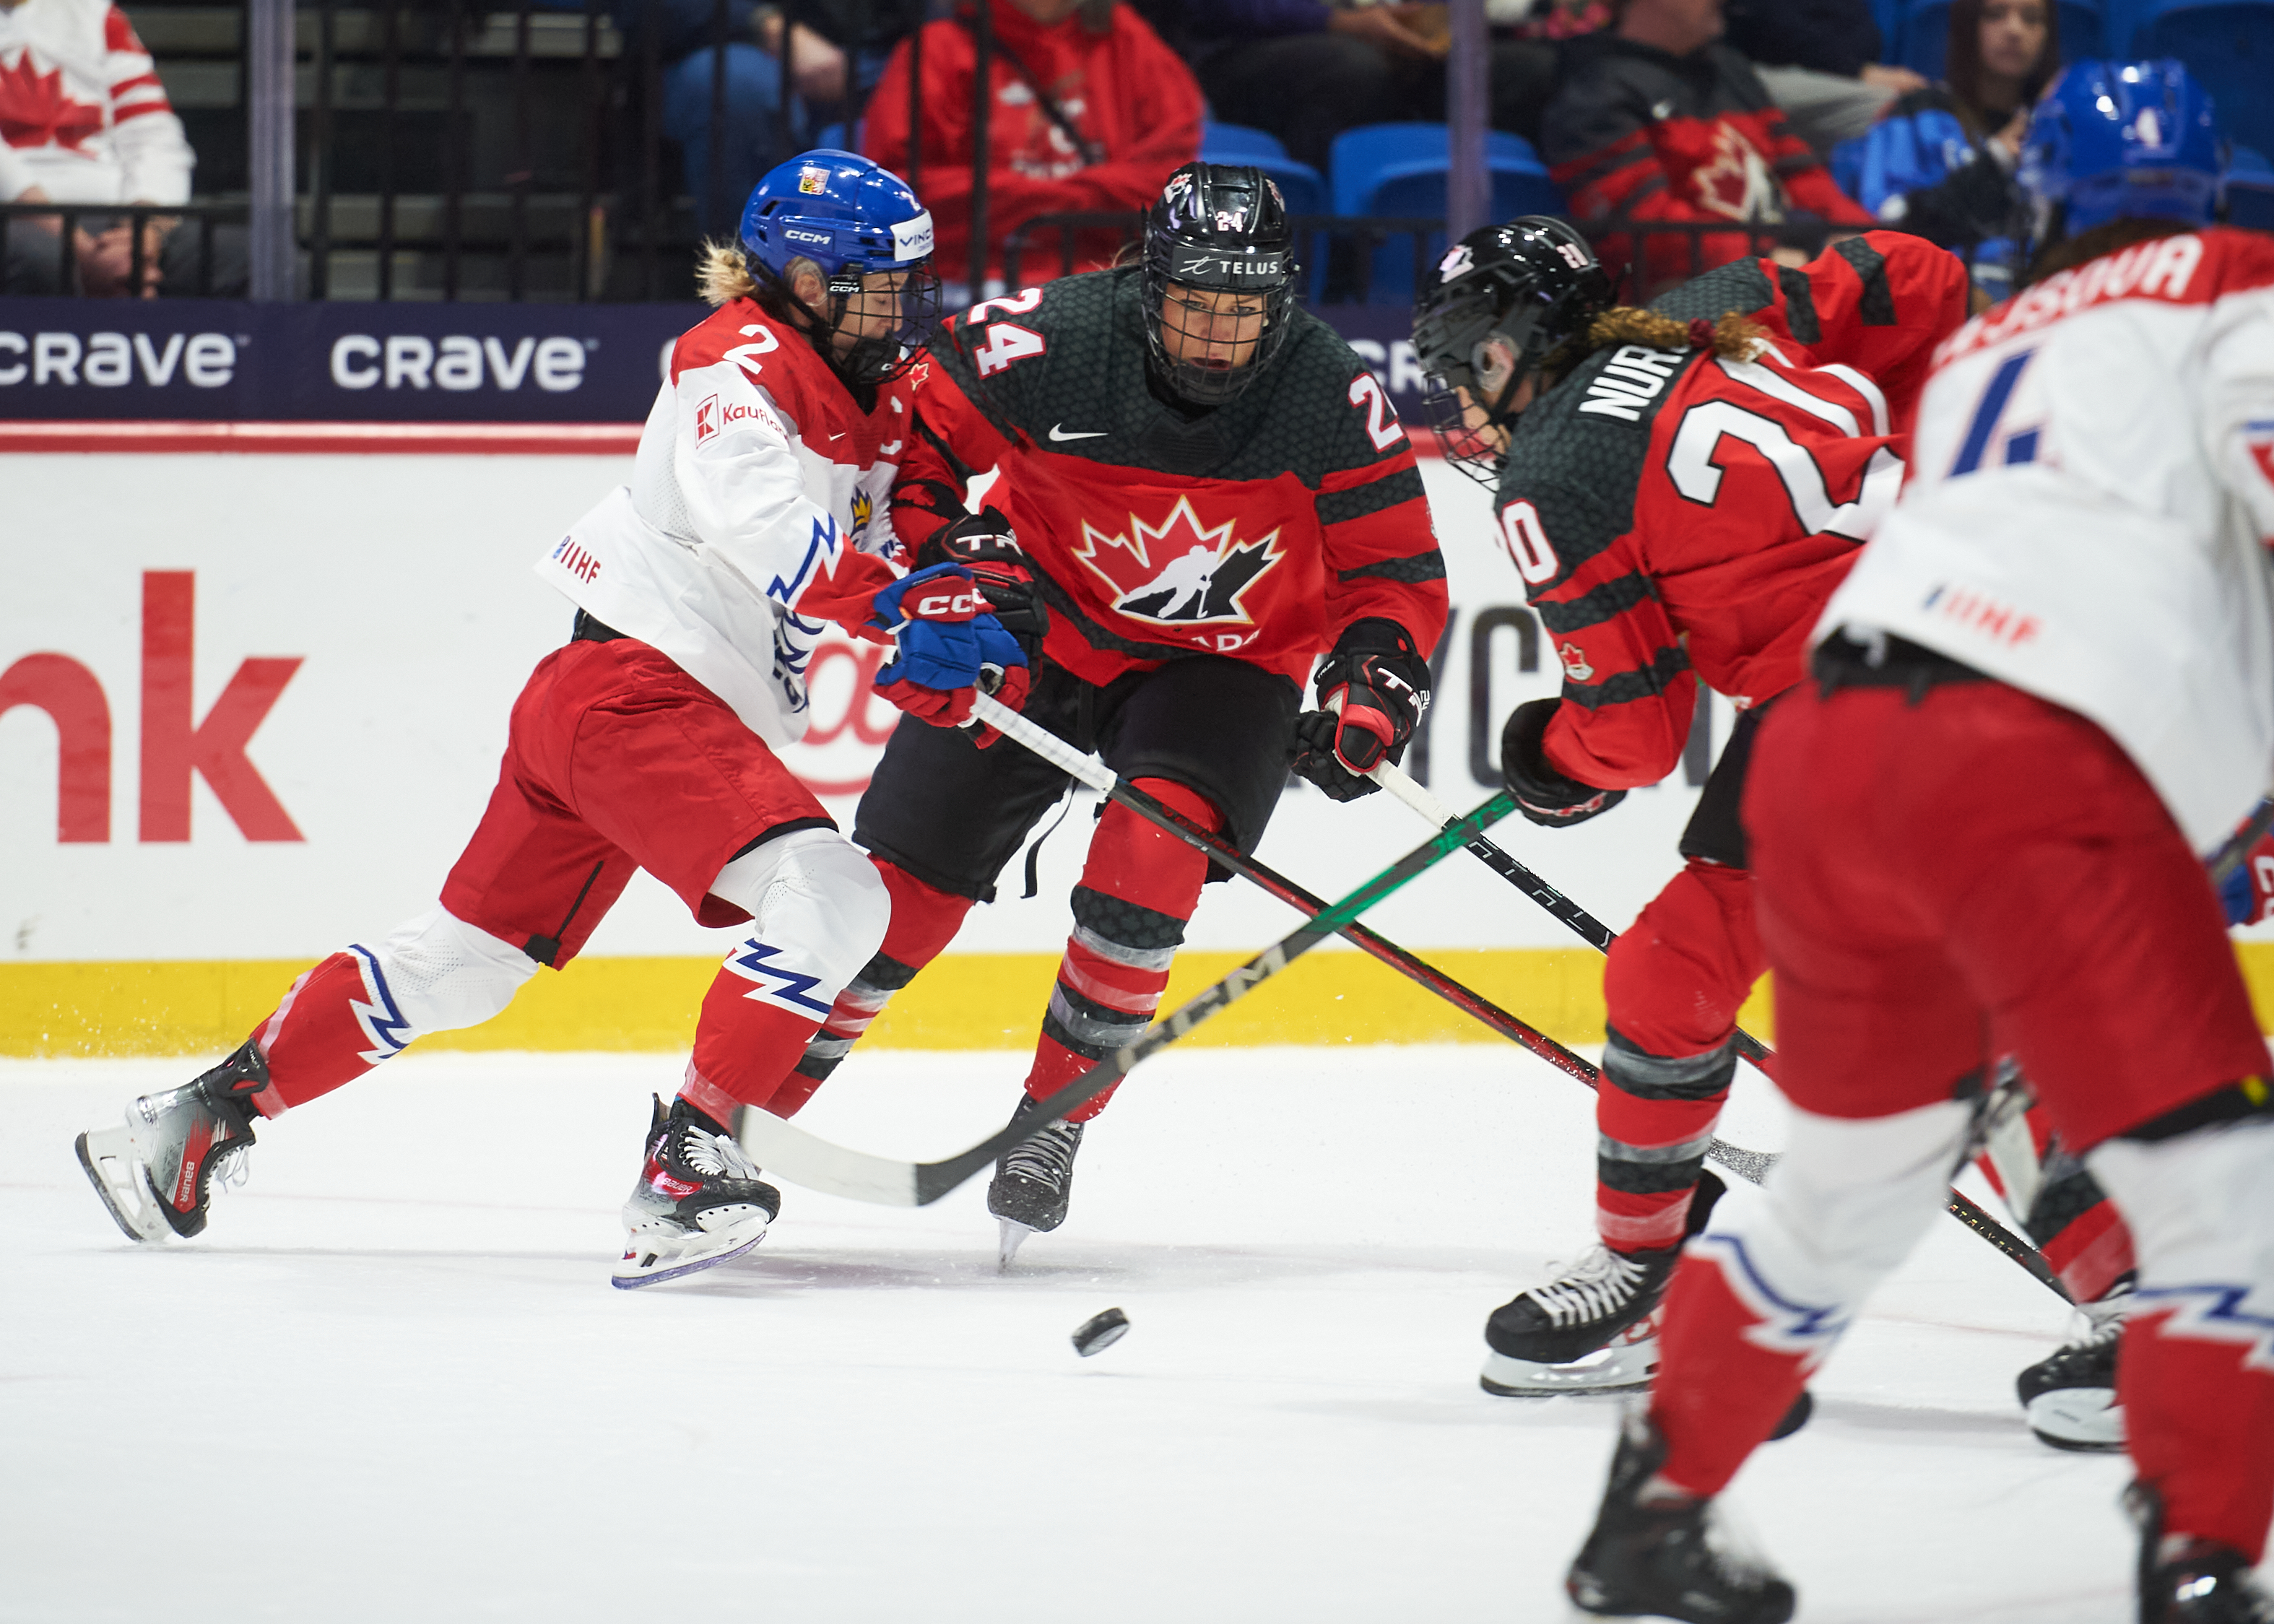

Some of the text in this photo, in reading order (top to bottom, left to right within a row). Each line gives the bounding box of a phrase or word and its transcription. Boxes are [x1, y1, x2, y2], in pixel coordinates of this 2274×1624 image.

[785, 230, 831, 245] CCM
[1218, 210, 1243, 233] 24
[1220, 261, 1278, 275] TELUS
[723, 324, 779, 374] 2
[966, 287, 1046, 380] 24
[1578, 344, 1691, 422] NUR
[1348, 372, 1405, 452] 2
[560, 541, 601, 584] IIHF
[1501, 498, 1560, 583] 0
